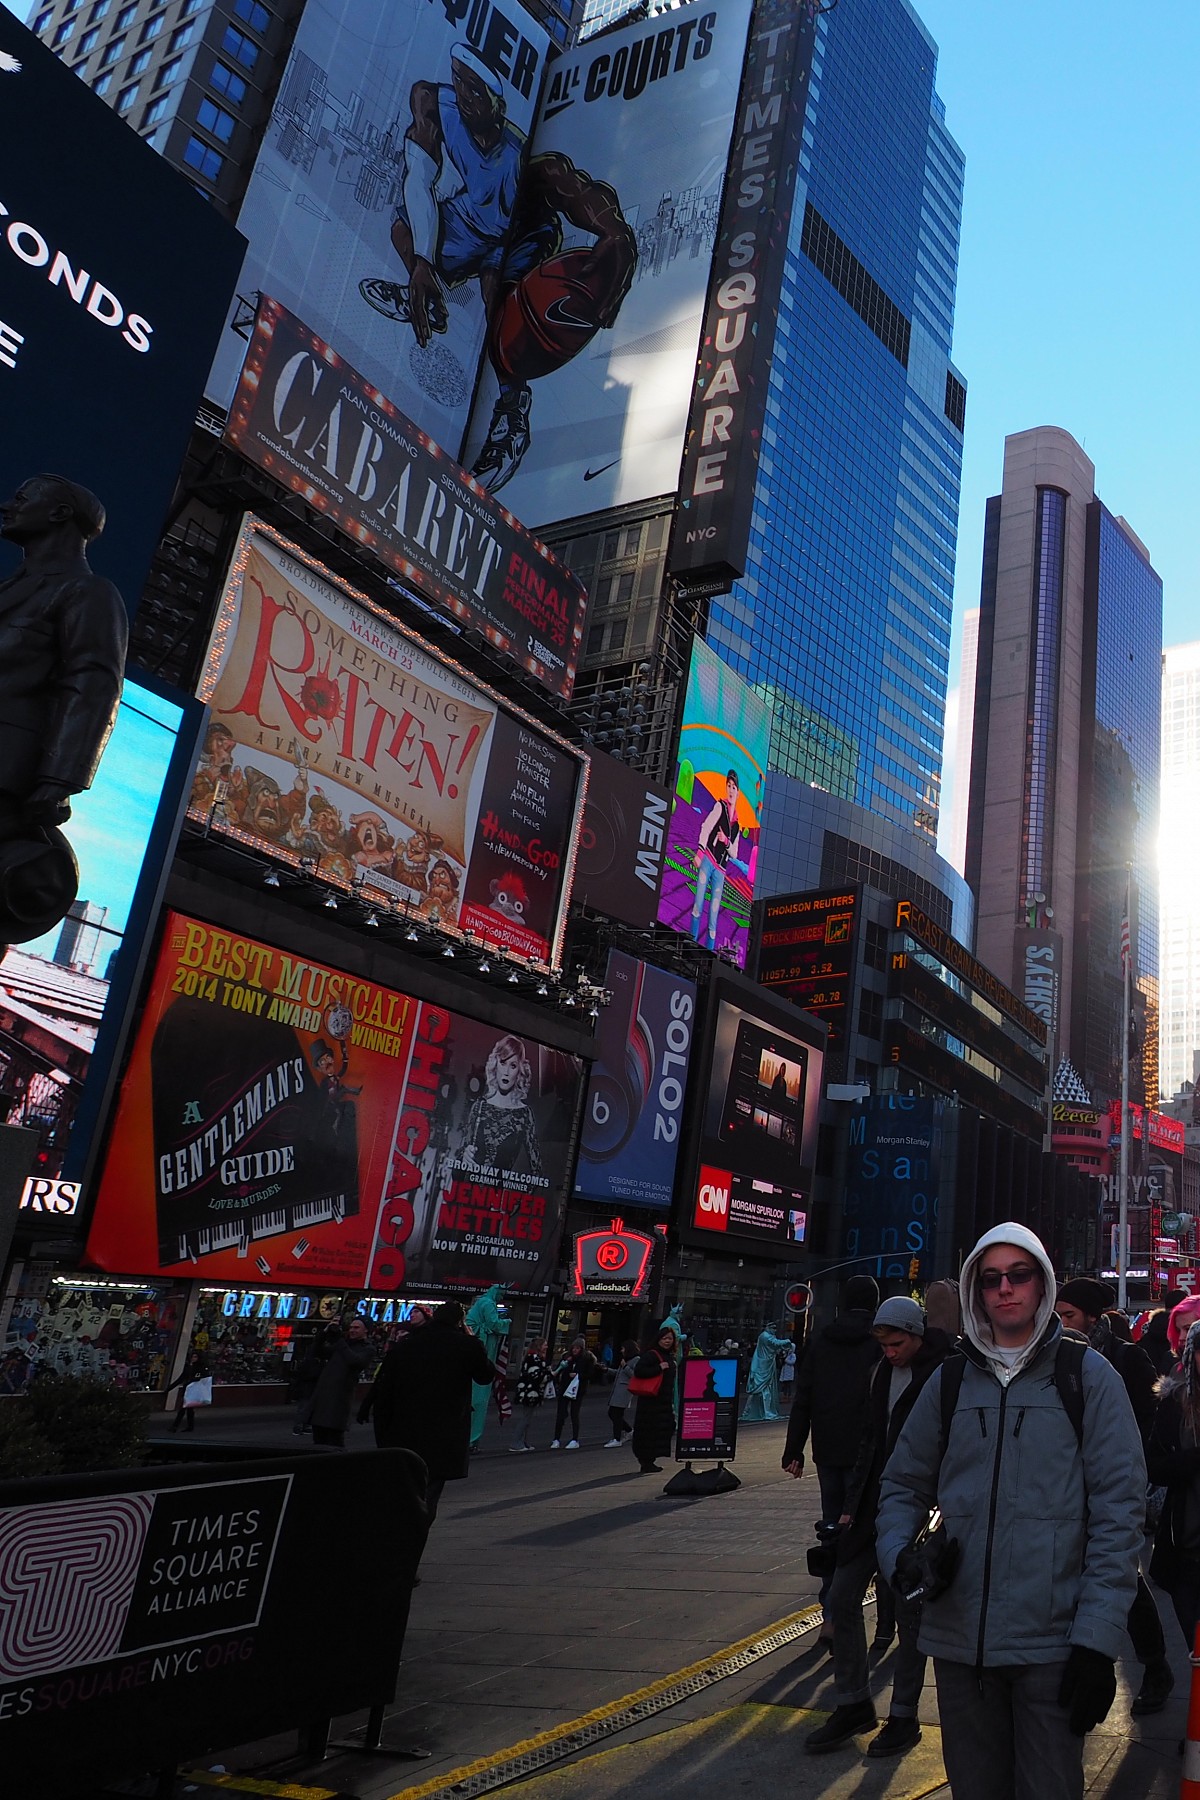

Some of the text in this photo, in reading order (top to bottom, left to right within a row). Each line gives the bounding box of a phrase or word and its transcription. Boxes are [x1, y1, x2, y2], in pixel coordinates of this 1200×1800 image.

[420, 0, 539, 100] UER
[544, 12, 717, 106] ALL COURTS
[737, 24, 792, 209] TIMES
[692, 230, 758, 497] SQUARE
[339, 385, 420, 459] ALAN CUMMING
[272, 351, 503, 601] CABARET
[440, 473, 497, 529] SIENNA MILLER
[359, 510, 381, 533] Studio
[685, 525, 718, 544] NYC
[508, 551, 569, 624] FINAL
[279, 558, 478, 704] BROADWAY PREVIEWS HOPEFULLY BEGIN
[350, 620, 414, 672] MARCH 23
[284, 590, 460, 725] SOMETHING
[255, 731, 433, 835] A VERY NEW MUSICAL
[514, 756, 550, 790] TRANSFER
[527, 755, 551, 778] LONDON
[516, 780, 546, 807] NO FILM
[479, 810, 559, 869] HAND GOD
[633, 790, 668, 892] NEW
[767, 894, 856, 918] THOMSON REUTERS
[762, 926, 823, 945] STOCK INDICES
[178, 922, 273, 989] BEST
[272, 954, 411, 1036] MUSICAL!
[615, 970, 628, 982] solo
[760, 962, 833, 982] 11057.99 3.52
[170, 966, 401, 1058] 2014 TONY AWARD WINNER
[808, 990, 841, 1004] -20.78
[653, 989, 693, 1143] SOLO 2
[160, 1057, 305, 1195] GENTLEMAN'S
[181, 1100, 204, 1125] A
[1052, 1103, 1100, 1125] Reese's
[368, 1004, 451, 1293] CHICAGO
[876, 1135, 931, 1148] Morgan Stanley
[220, 1145, 295, 1187] GUIDE
[447, 1159, 550, 1188] BROADWAY WELCOMES
[469, 1174, 501, 1188] GRAMMY
[608, 1175, 671, 1194] DESIGNED FOR SOUND
[443, 1180, 546, 1218] JENNIFER
[611, 1185, 670, 1201] TUNED FOR EMOTION
[699, 1183, 729, 1215] CNN
[1097, 1173, 1164, 1203] SHY'S
[437, 1203, 544, 1242] NETTLES
[730, 1198, 756, 1214] MORGAN
[756, 1203, 785, 1220] SPURLOCK
[431, 1239, 540, 1262] NOW THRU MARCH 29
[464, 1232, 515, 1247] OF SUGARLAND
[585, 1282, 632, 1293] radioshack
[221, 1292, 416, 1323] GRAND SLAM
[170, 1509, 262, 1547] TIMES
[148, 1542, 264, 1586] SQUARE
[146, 1578, 251, 1616] ALLIANCE
